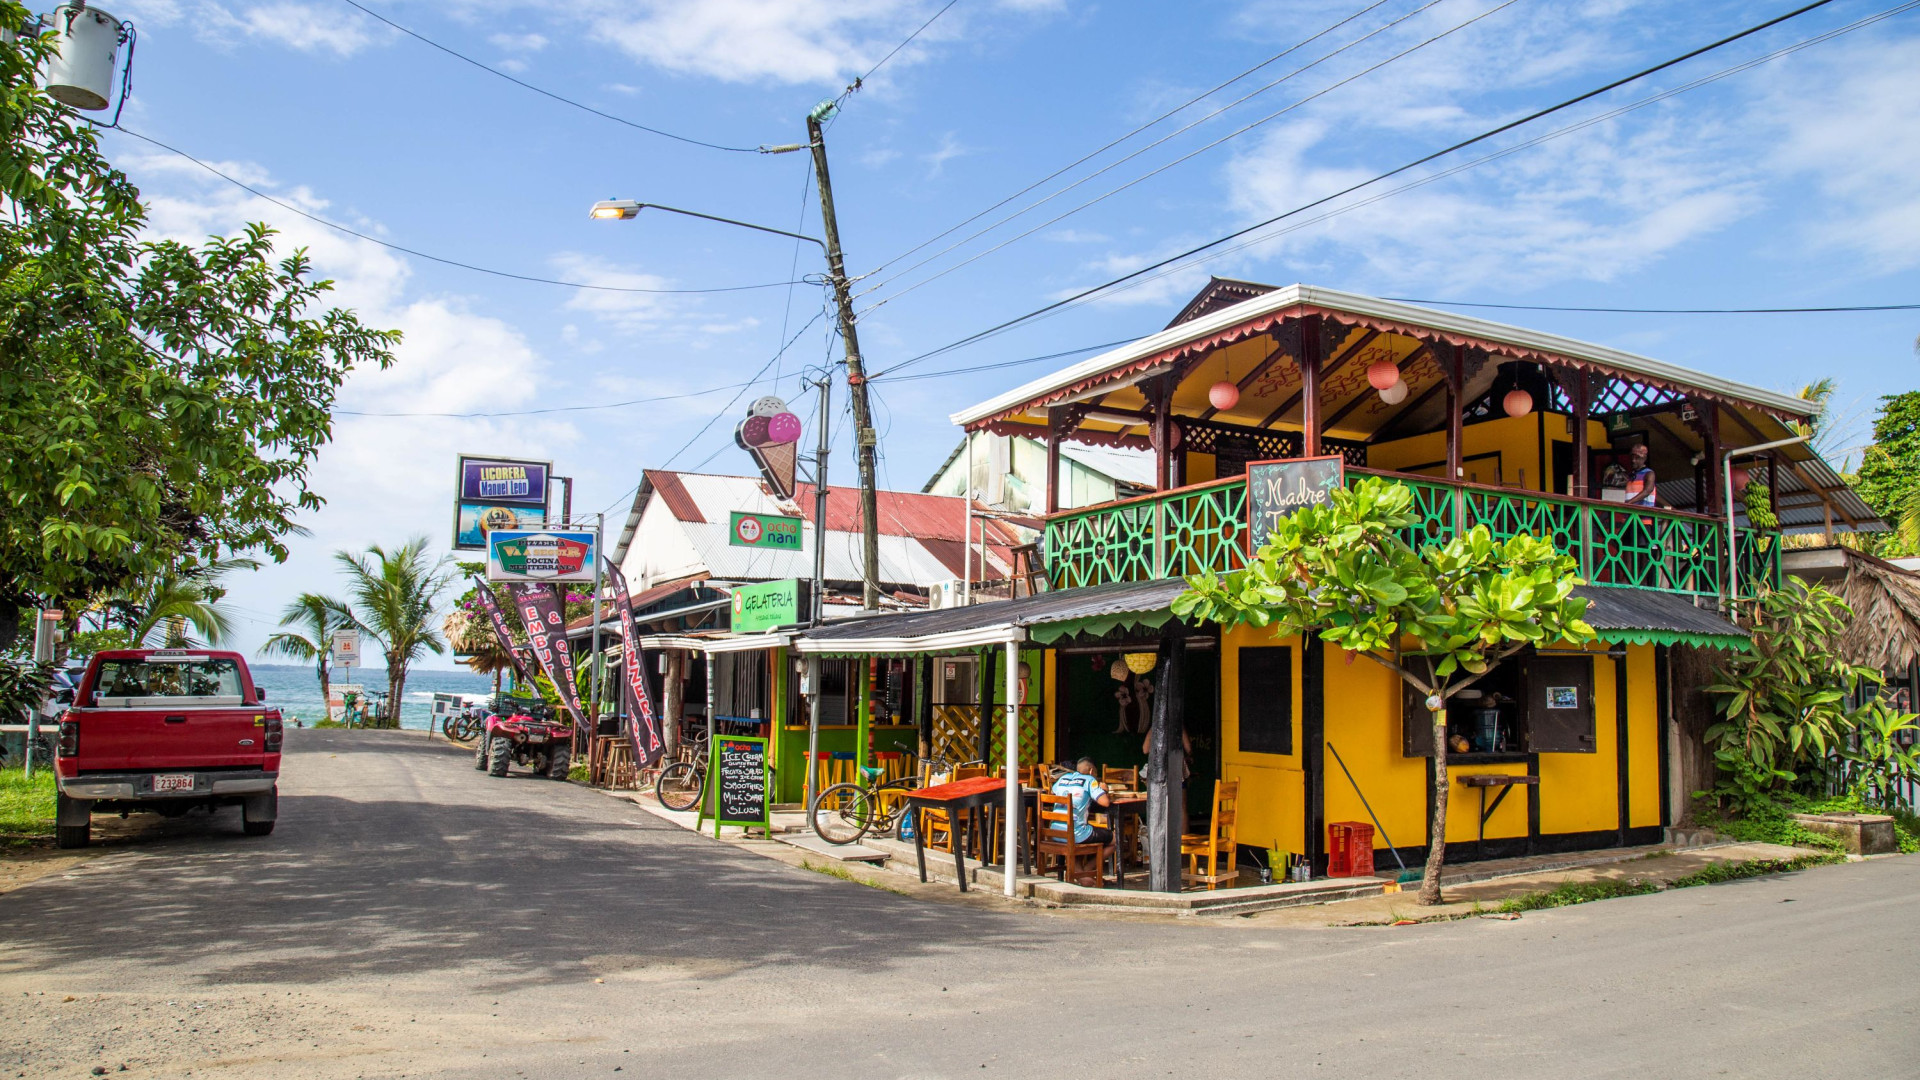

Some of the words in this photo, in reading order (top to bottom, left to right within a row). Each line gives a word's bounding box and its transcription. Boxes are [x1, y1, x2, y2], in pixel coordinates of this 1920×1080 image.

[480, 467, 526, 480] LICORERA
[481, 481, 508, 496] Manuel
[1265, 476, 1326, 507] Madre
[767, 522, 796, 533] ocho
[768, 533, 796, 544] nani
[745, 591, 793, 614] GELATERIA
[722, 752, 741, 763] ICE
[723, 791, 744, 804] MILK
[727, 806, 760, 815] SLUSH
